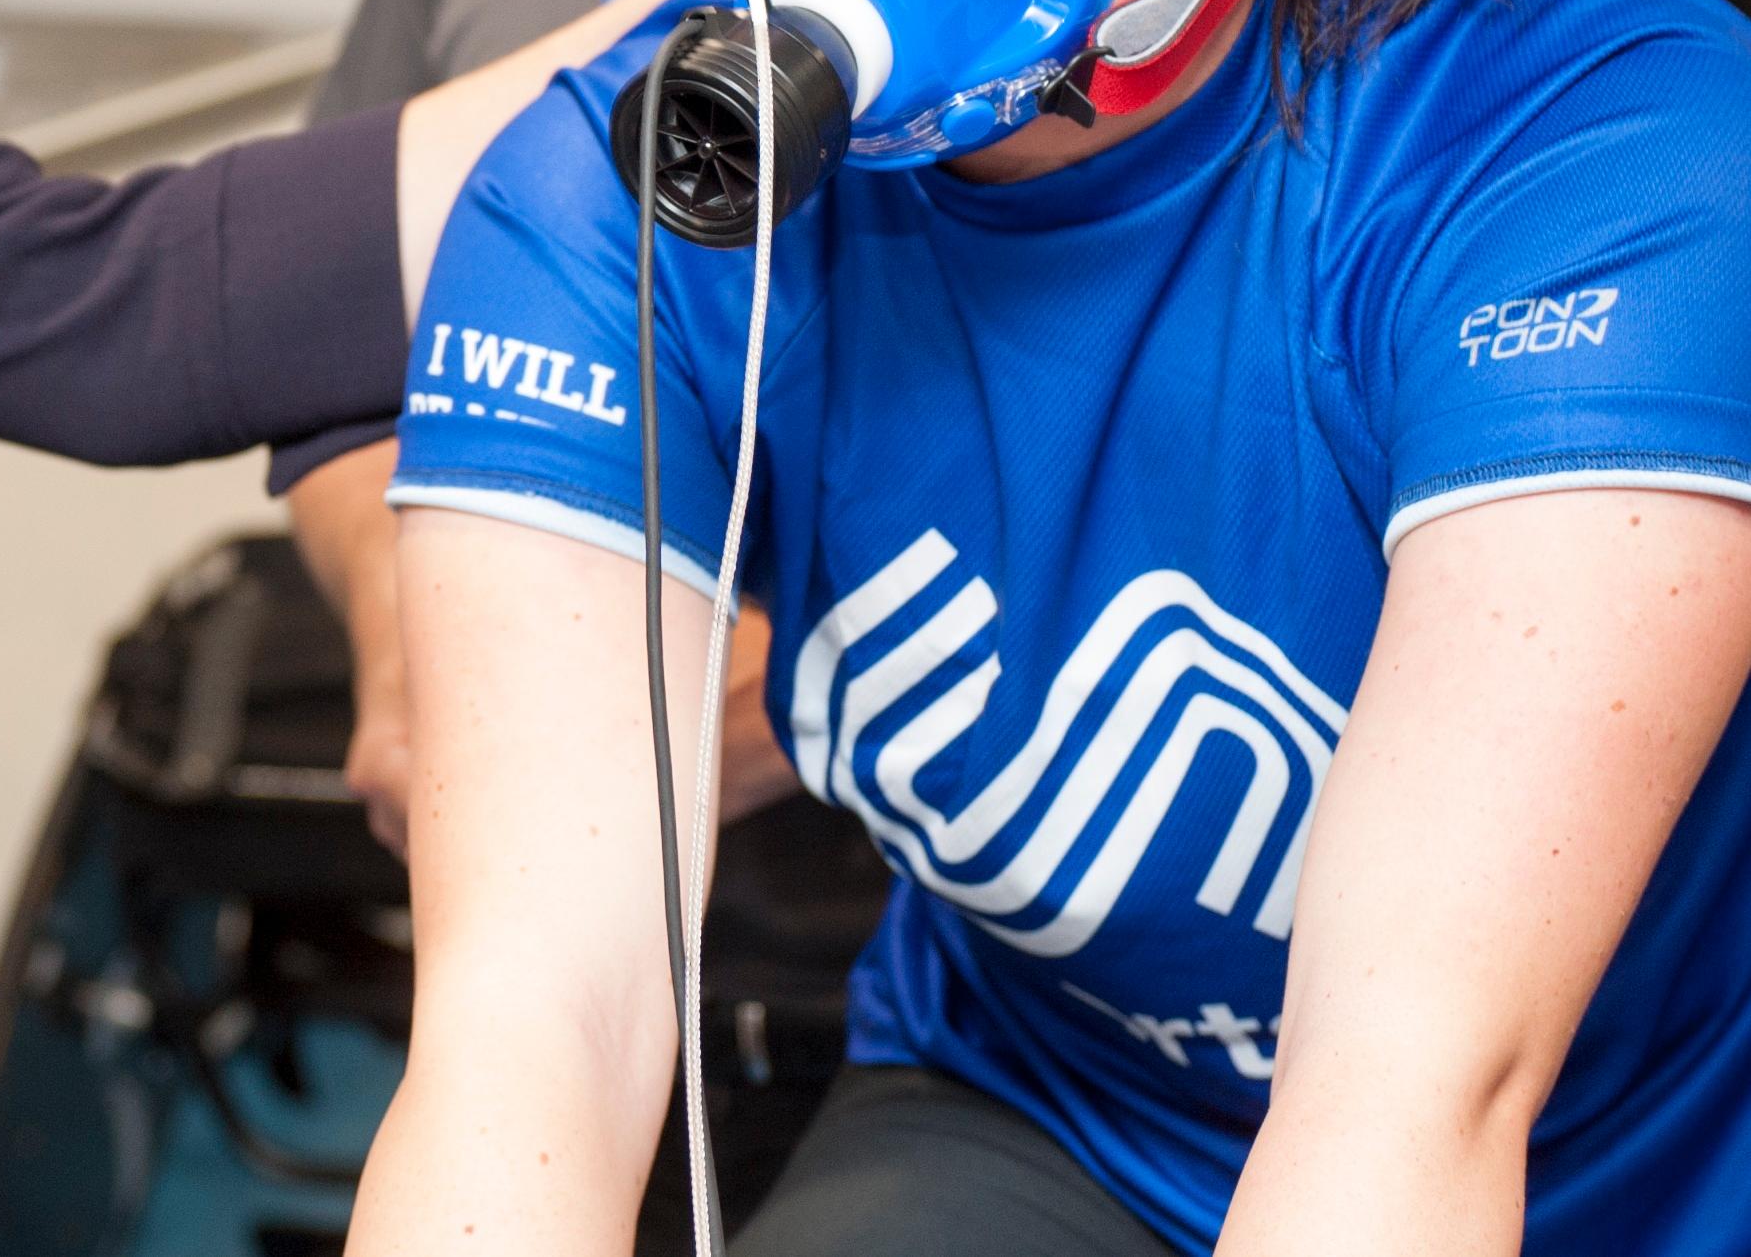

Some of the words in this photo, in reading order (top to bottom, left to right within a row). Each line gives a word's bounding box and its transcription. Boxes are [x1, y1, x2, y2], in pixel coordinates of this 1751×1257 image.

[427, 323, 452, 377] I
[460, 327, 627, 427] WILL
[1458, 316, 1609, 368] TOON
